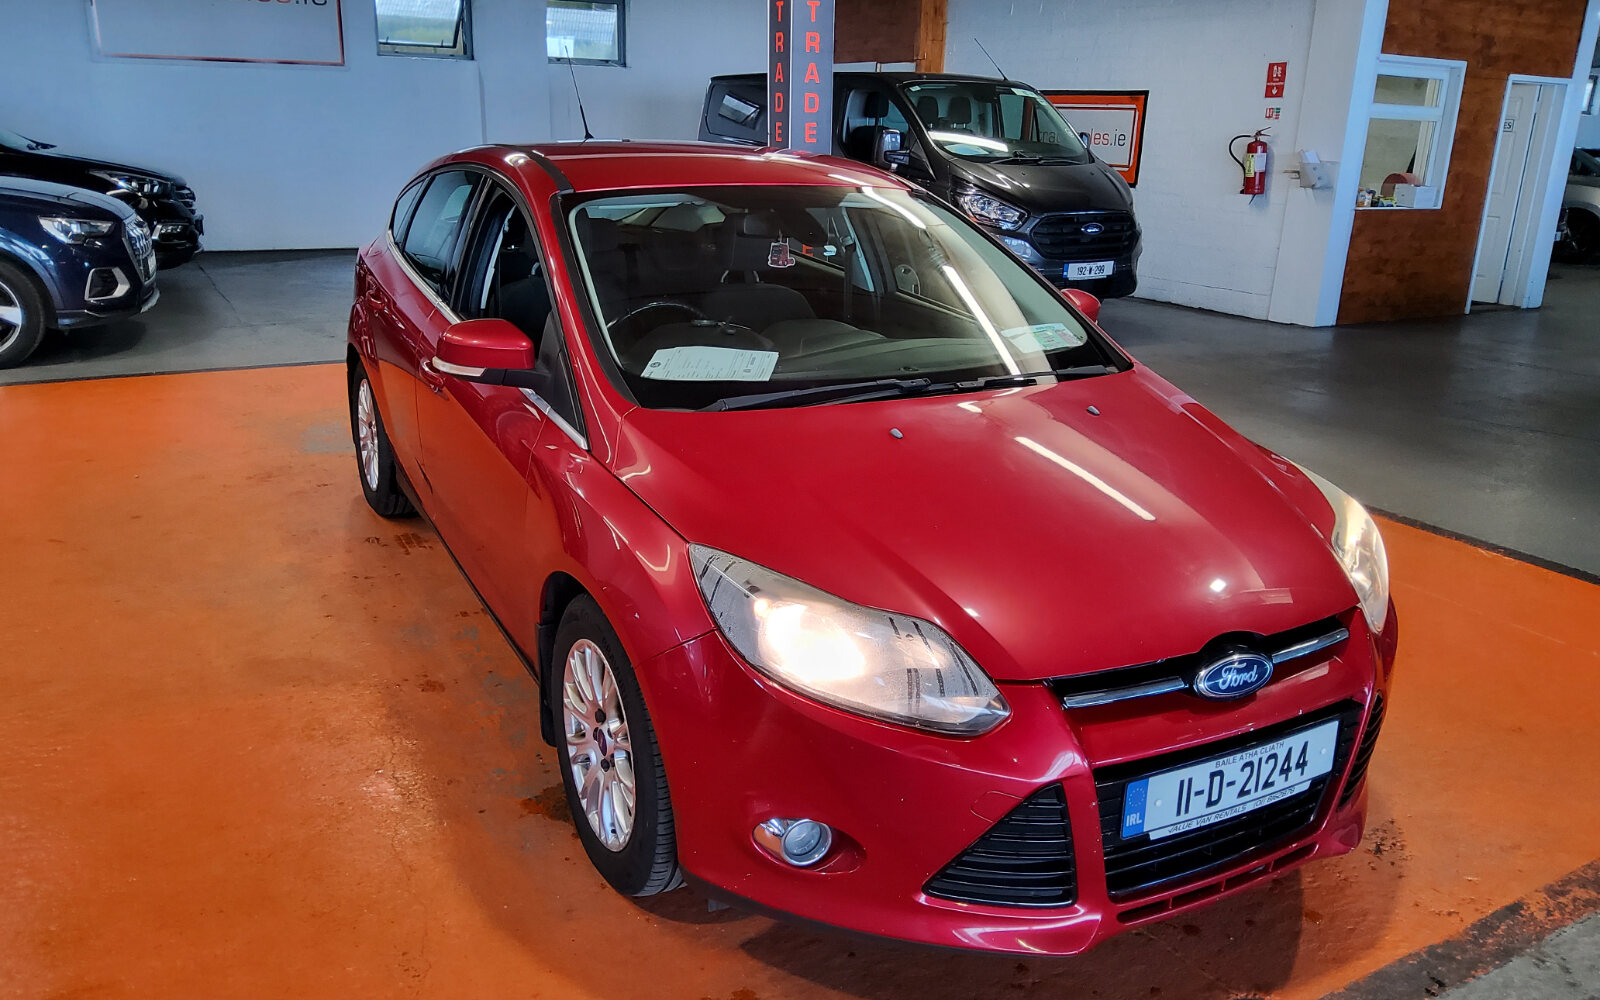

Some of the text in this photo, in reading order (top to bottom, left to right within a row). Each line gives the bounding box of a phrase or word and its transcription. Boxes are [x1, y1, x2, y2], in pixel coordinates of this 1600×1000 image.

[775, 0, 785, 142] TRADE
[804, 0, 821, 143] TRADE
[1218, 662, 1259, 690] Ford
[1215, 741, 1285, 769] BAILE ATHA CLIATH
[1175, 741, 1309, 817] 11-D-21244
[1126, 812, 1143, 827] IRL
[1168, 822, 1194, 834] VALUE
[1196, 816, 1212, 827] VAN
[1214, 805, 1247, 820] RENTALS
